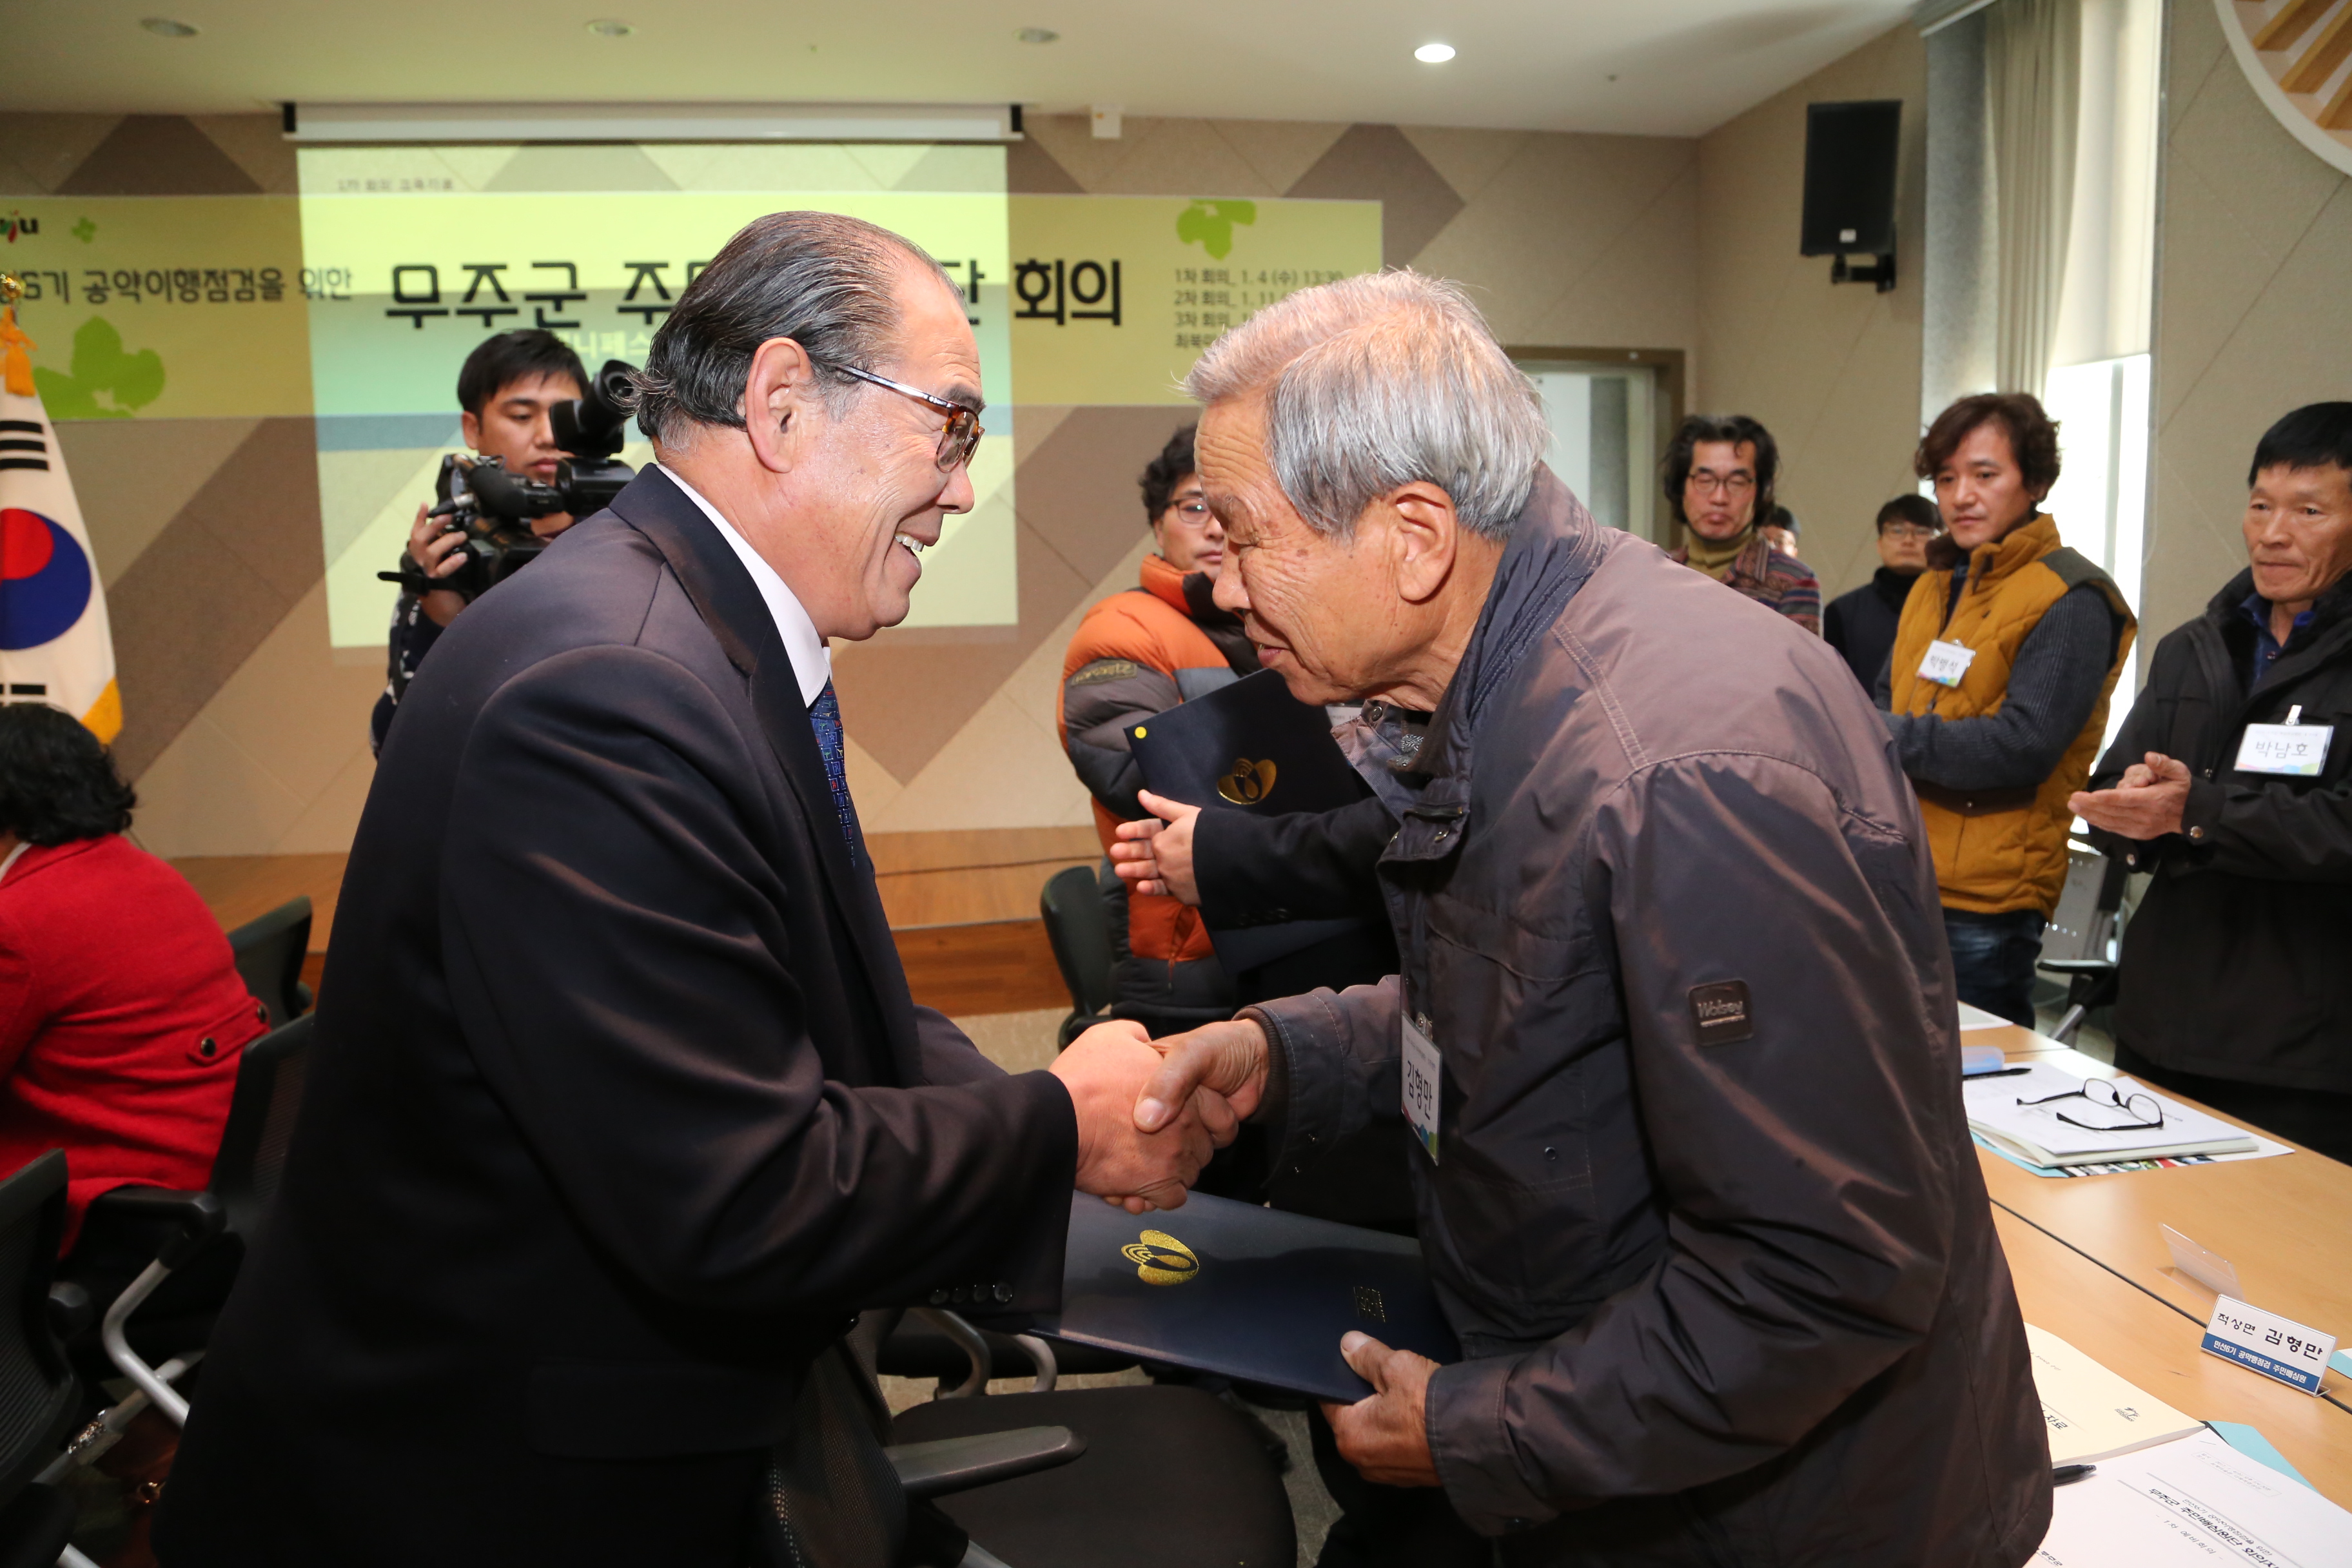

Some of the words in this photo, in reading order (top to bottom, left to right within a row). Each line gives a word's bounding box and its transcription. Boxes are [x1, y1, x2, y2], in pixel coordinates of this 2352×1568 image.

[82, 268, 286, 304] 공약이행점검을
[298, 268, 352, 300] 위한
[386, 262, 586, 328] 무주군
[1015, 259, 1121, 326] 회의
[2255, 741, 2308, 759] 박남호
[1407, 1060, 1433, 1121] 김형만
[2217, 1313, 2256, 1336] 적상면
[2265, 1328, 2323, 1361] 김형만
[2213, 1340, 2237, 1356] 민선6기
[2273, 1364, 2307, 1384] 주민배심원
[2043, 1410, 2068, 1430] 자료
[2148, 1488, 2180, 1506] 무주군
[2180, 1506, 2243, 1546] 주민배심원단
